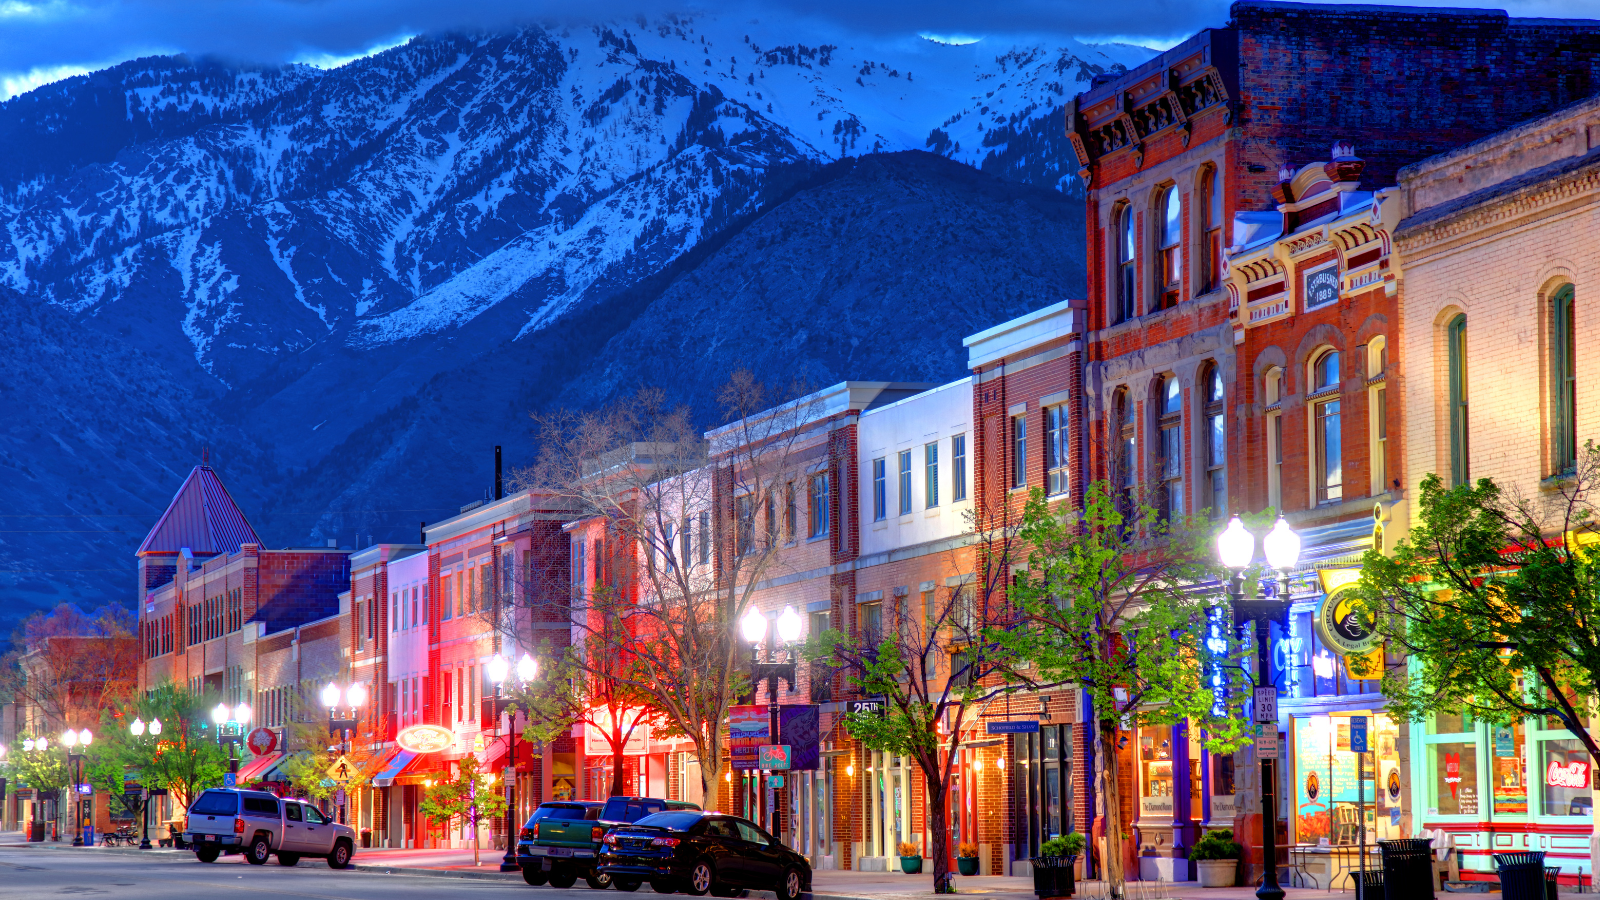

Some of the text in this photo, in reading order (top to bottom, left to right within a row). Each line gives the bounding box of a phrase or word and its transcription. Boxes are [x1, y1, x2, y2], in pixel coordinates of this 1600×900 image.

[1308, 273, 1338, 297] ESTABLISHED
[1316, 288, 1332, 302] 1889
[1326, 590, 1344, 632] GROUND
[1342, 641, 1361, 649] Legal
[1260, 703, 1272, 712] 30
[1256, 726, 1263, 737] 2
[796, 745, 819, 767] STATE
[1149, 803, 1162, 811] Diamond
[1162, 803, 1172, 811] Room
